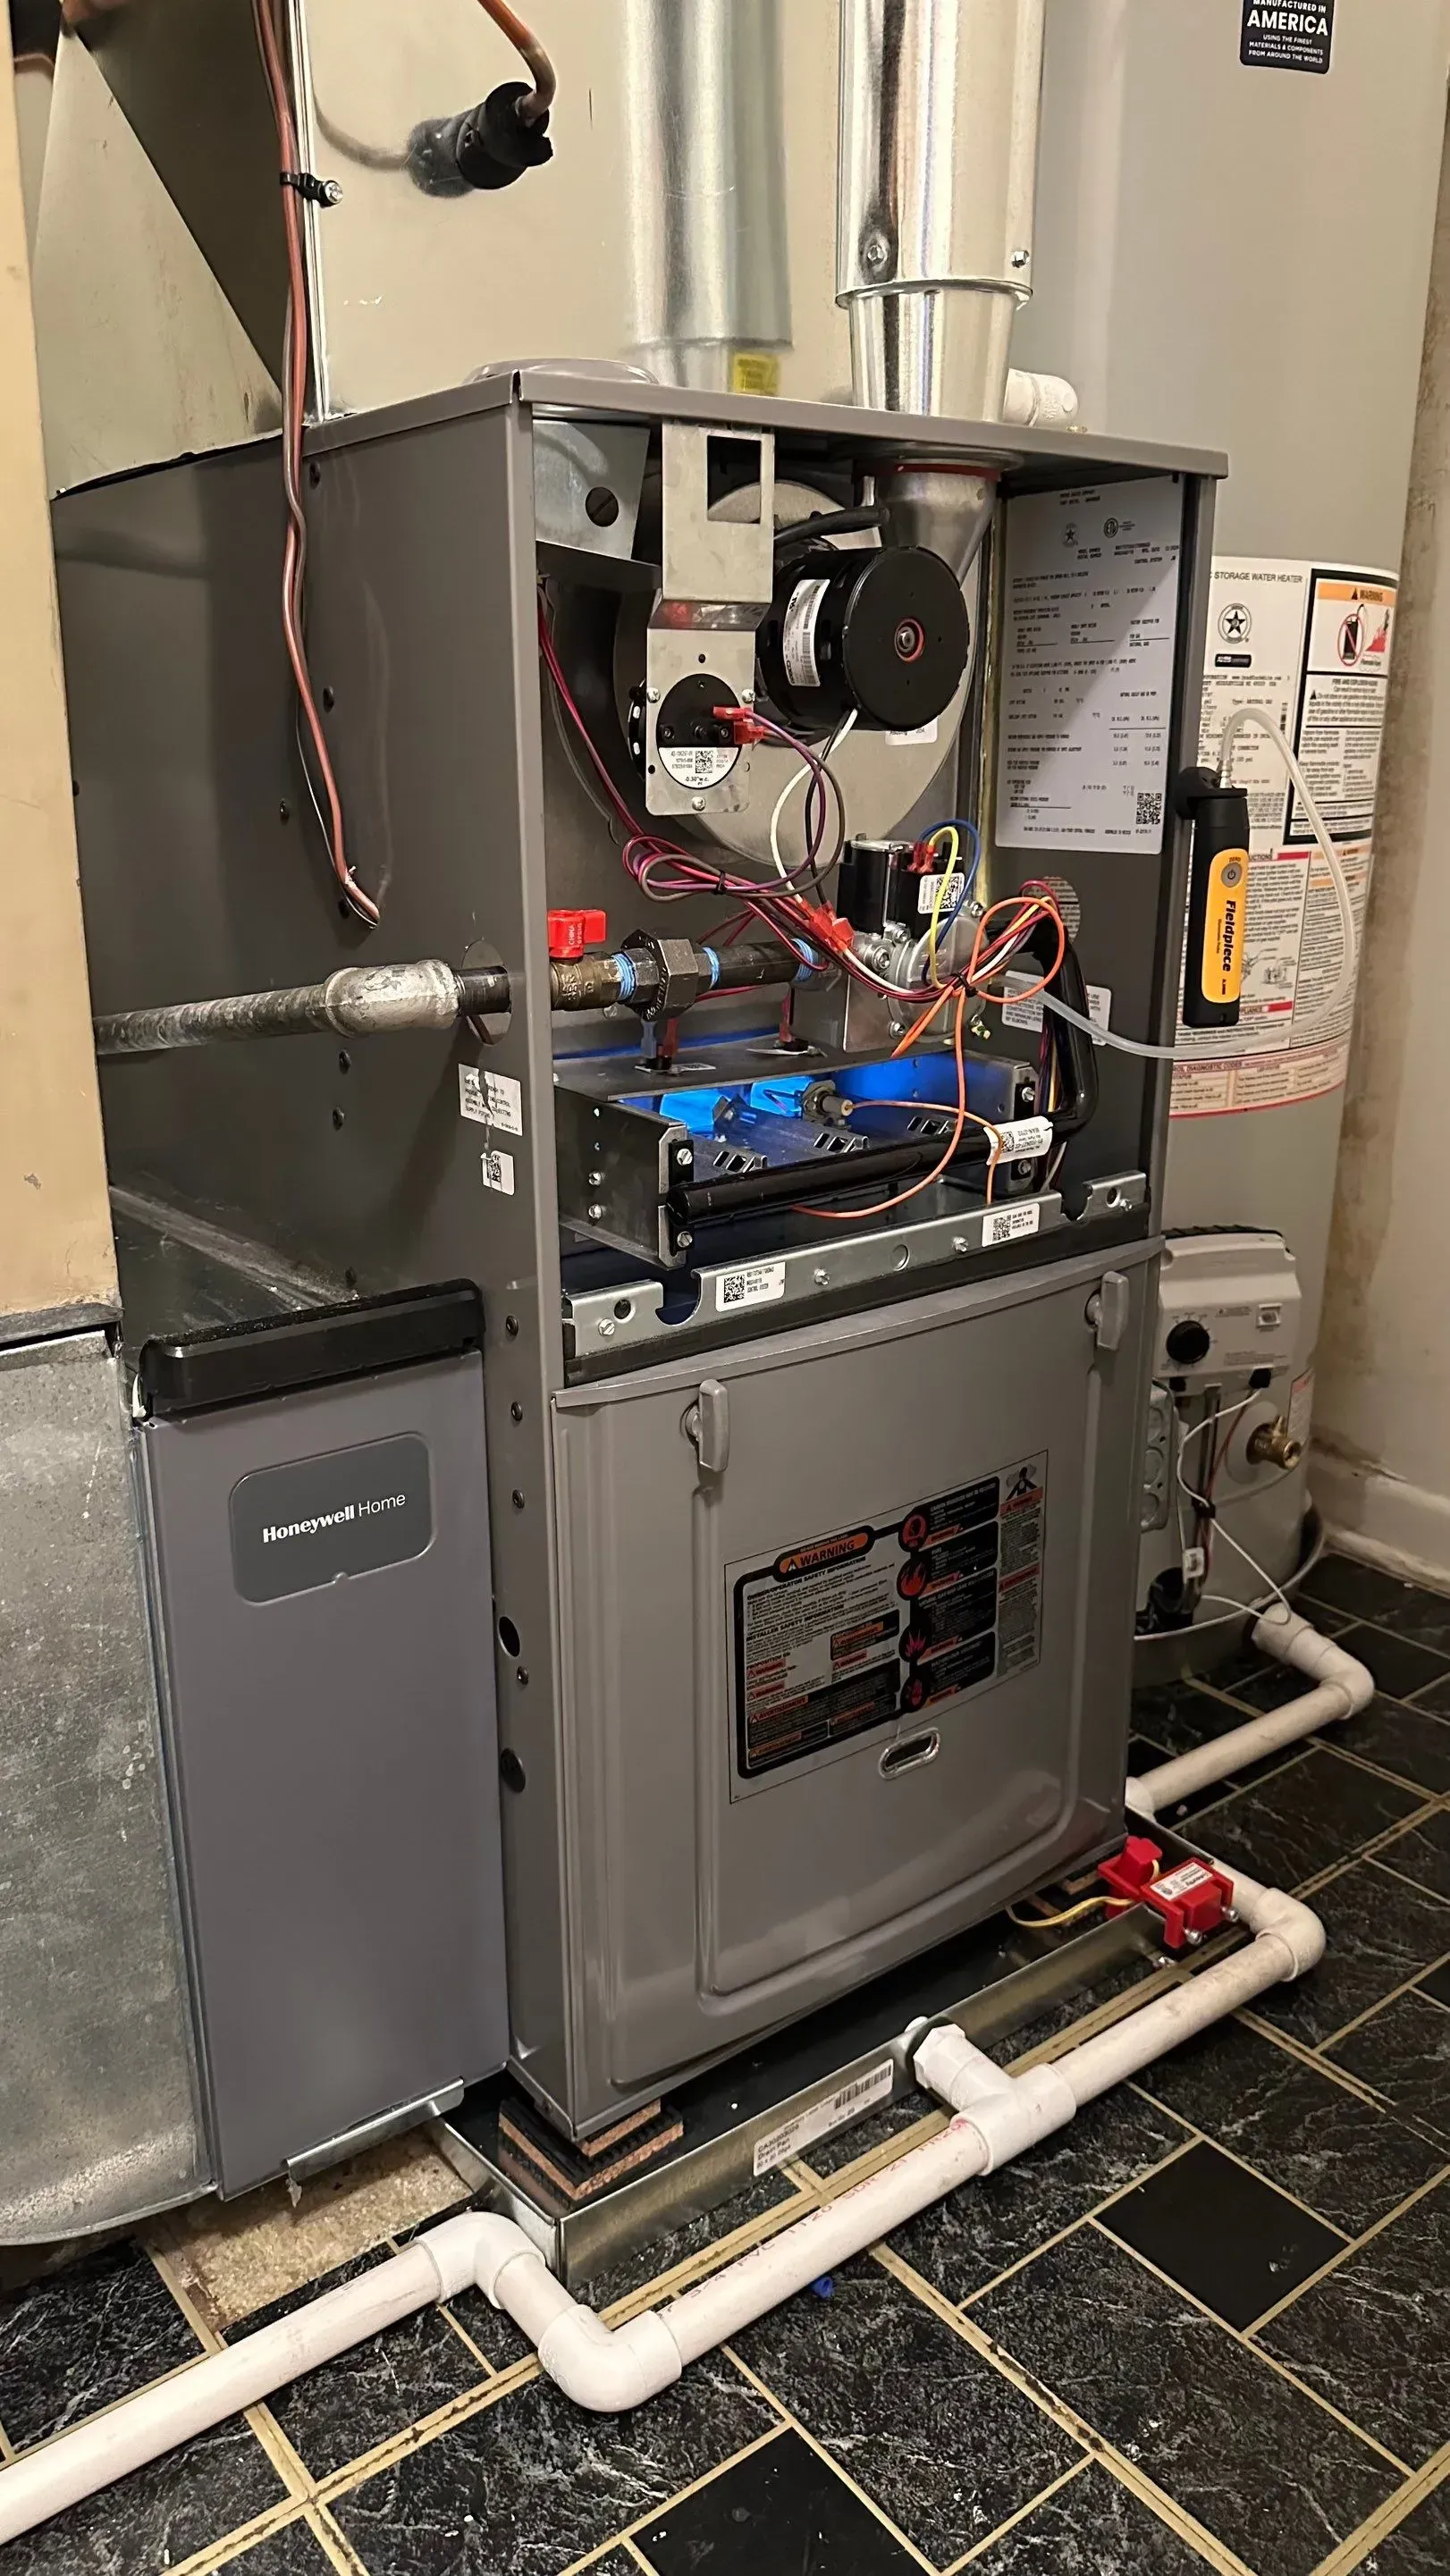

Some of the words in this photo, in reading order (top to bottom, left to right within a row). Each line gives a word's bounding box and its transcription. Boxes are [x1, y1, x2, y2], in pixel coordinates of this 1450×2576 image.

[1253, 0, 1317, 12] MANUFACTURED
[1318, 4, 1326, 13] IN
[1247, 10, 1328, 36] AMERICA
[1263, 34, 1281, 42] USING
[1294, 38, 1312, 46] FINEST
[1249, 41, 1281, 50] MATERIALS
[1287, 45, 1323, 55] COMPONENTS
[1267, 51, 1291, 59] AROUND
[1303, 55, 1323, 63] WORLD
[1214, 572, 1251, 581] STORAGE
[1277, 575, 1303, 583] HEATER
[1360, 589, 1383, 602] WARNING
[1223, 900, 1236, 972] Fieldpiece
[263, 1505, 355, 1544] Honeywell
[358, 1492, 406, 1518] Home
[800, 1539, 855, 1567] WARNING
